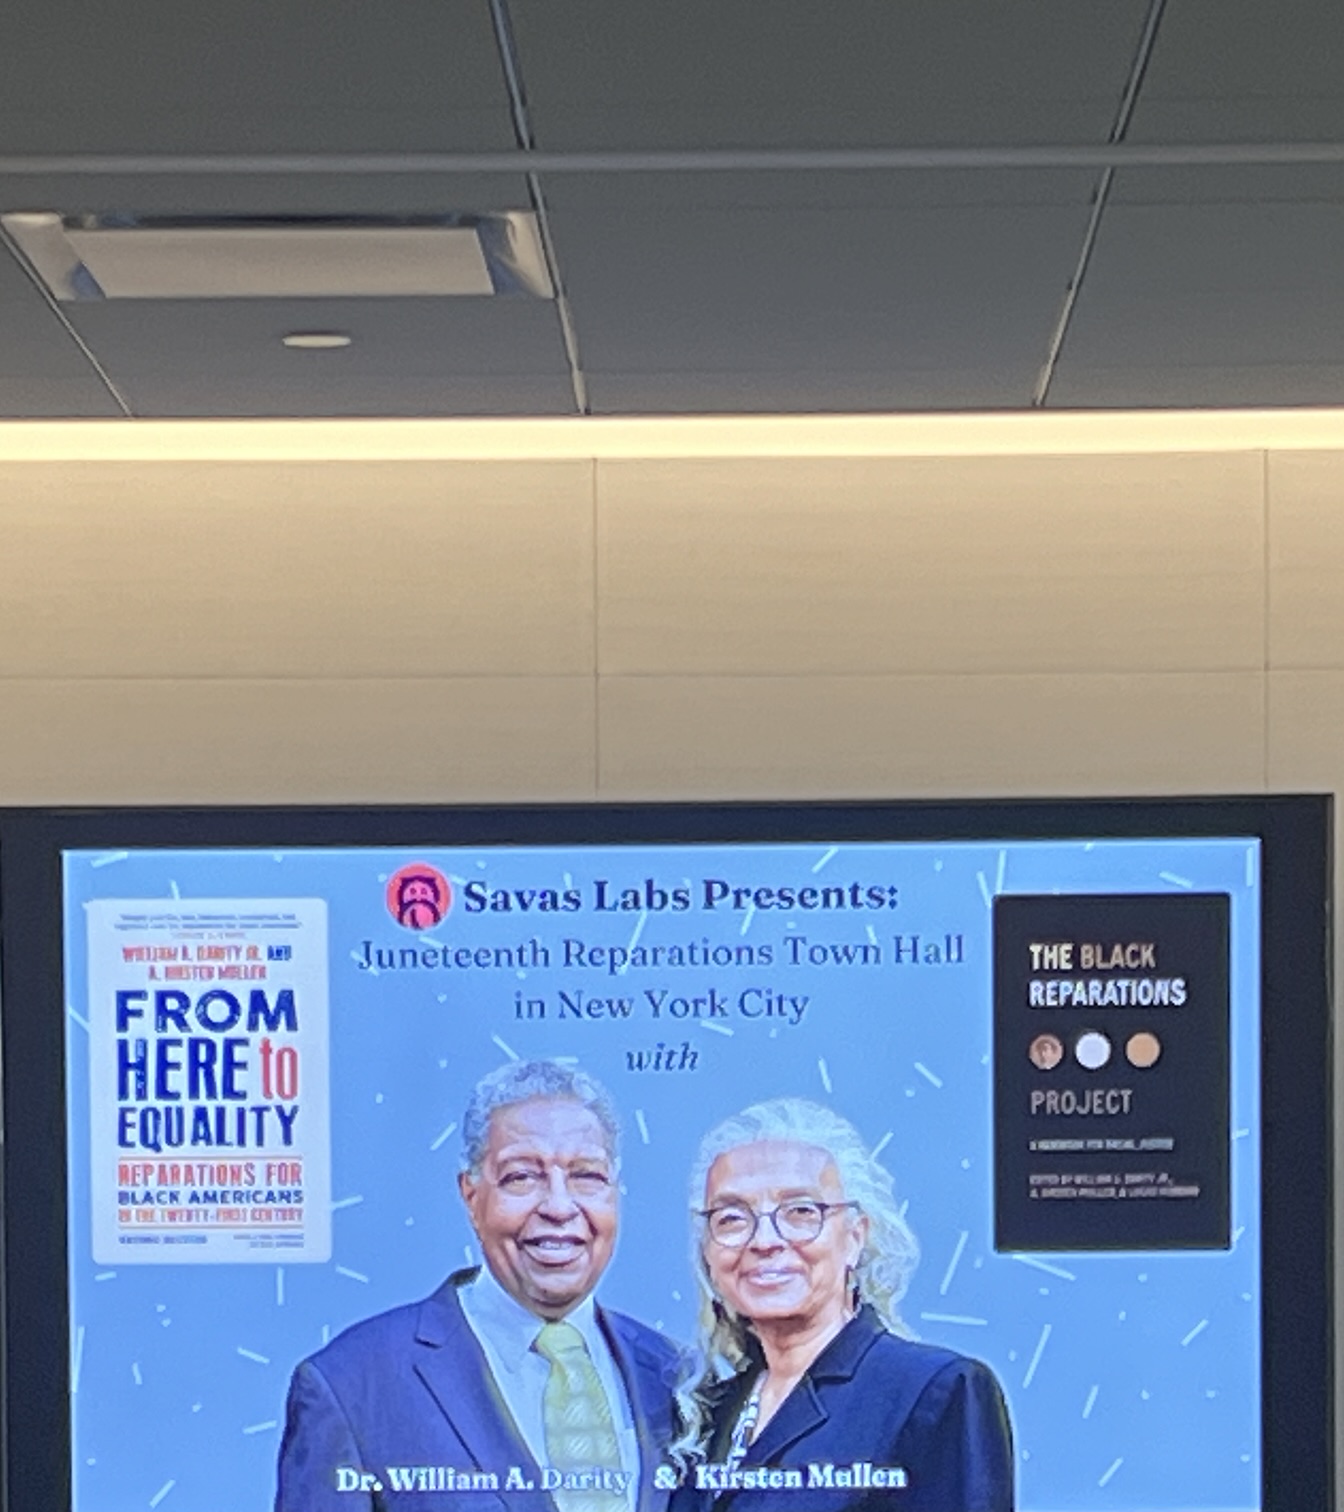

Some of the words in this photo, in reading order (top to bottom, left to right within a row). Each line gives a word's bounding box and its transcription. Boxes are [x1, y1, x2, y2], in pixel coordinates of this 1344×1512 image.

[464, 880, 582, 912] Savas
[593, 879, 690, 911] Labs
[702, 880, 898, 910] Presents:
[359, 938, 550, 970] Juneteenth
[563, 936, 774, 976] Reparations
[784, 936, 881, 965] Town
[893, 934, 964, 964] Hall
[1029, 943, 1074, 970] THE
[1080, 943, 1156, 969] BLACK
[514, 990, 546, 1019] in
[558, 990, 634, 1019] New
[644, 988, 729, 1019] York
[738, 988, 810, 1025] City
[1029, 978, 1187, 1007] REPARATIONS
[116, 989, 299, 1033] FROM
[117, 1037, 250, 1101] HERE
[259, 1036, 298, 1100] to
[626, 1042, 699, 1072] with
[1030, 1088, 1133, 1115] PROJECT
[117, 1105, 299, 1152] EQUALITY
[118, 1162, 256, 1187] REPARATIONS
[265, 1162, 302, 1187] FOR
[118, 1190, 180, 1206] BLACK
[188, 1189, 304, 1205] AMERICANS
[337, 1467, 384, 1492] Dr.
[386, 1466, 500, 1492] William
[505, 1468, 534, 1491] A.
[541, 1467, 632, 1495] Darity
[654, 1464, 677, 1490] &
[695, 1463, 803, 1490] Kirsten
[807, 1462, 907, 1489] Mullen
